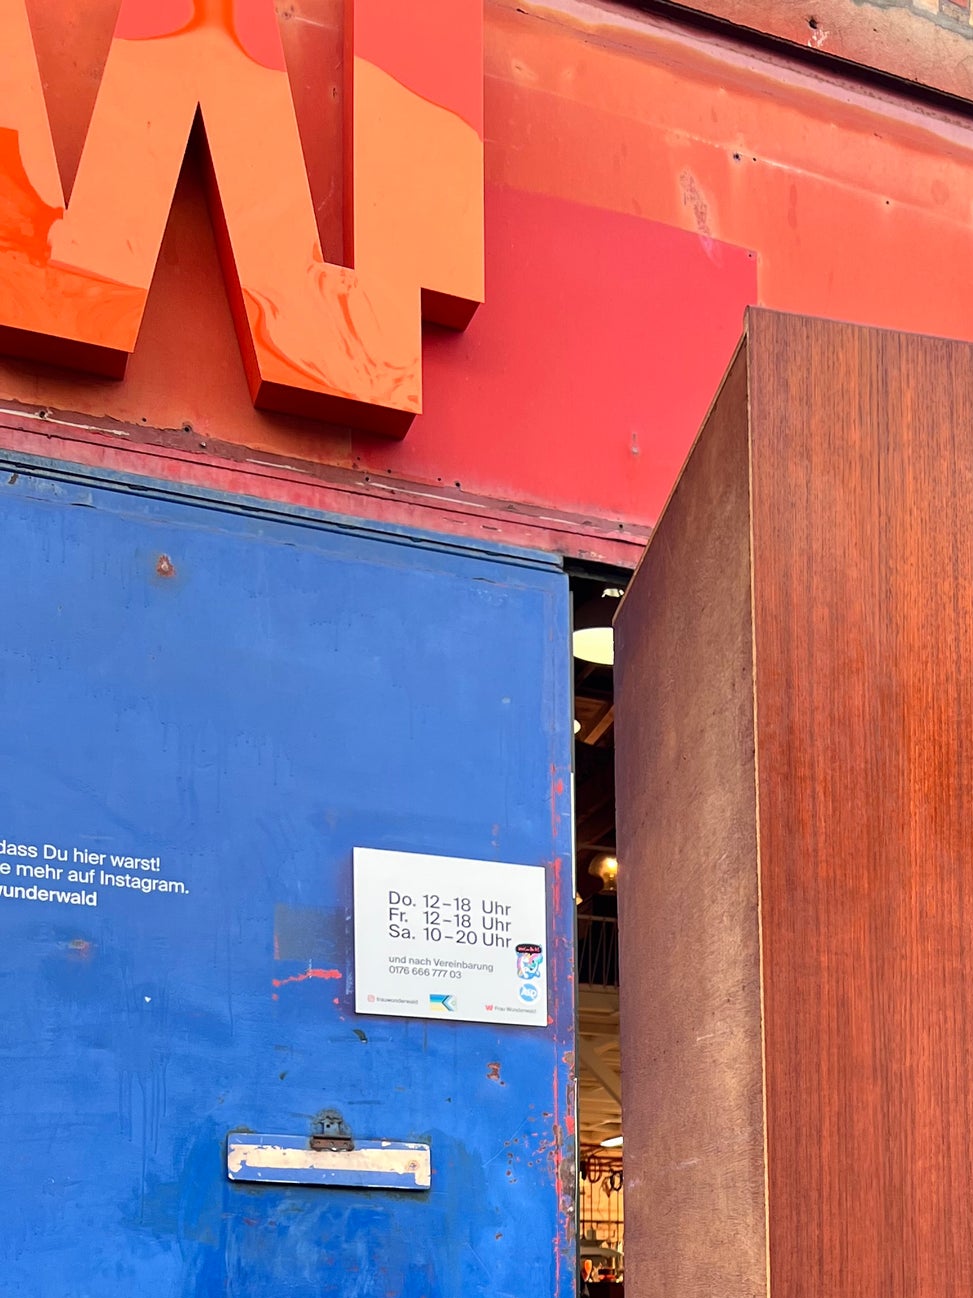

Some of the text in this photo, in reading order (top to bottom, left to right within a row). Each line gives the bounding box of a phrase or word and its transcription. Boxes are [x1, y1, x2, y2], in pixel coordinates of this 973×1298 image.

[43, 844, 68, 861] Du
[73, 848, 106, 865] hier
[110, 855, 161, 872] warst!
[16, 864, 63, 880] mehr
[67, 869, 95, 884] auf
[100, 871, 190, 895] Instagram.
[388, 890, 416, 907] Do.
[482, 899, 512, 916] Uhr
[389, 907, 409, 923] Fr.
[482, 916, 512, 932] Uhr
[388, 923, 416, 940] Sa.
[482, 932, 512, 948] Uhr
[388, 955, 494, 973] und nach Vereinbarung
[388, 966, 462, 979] 0176 666 777 03
